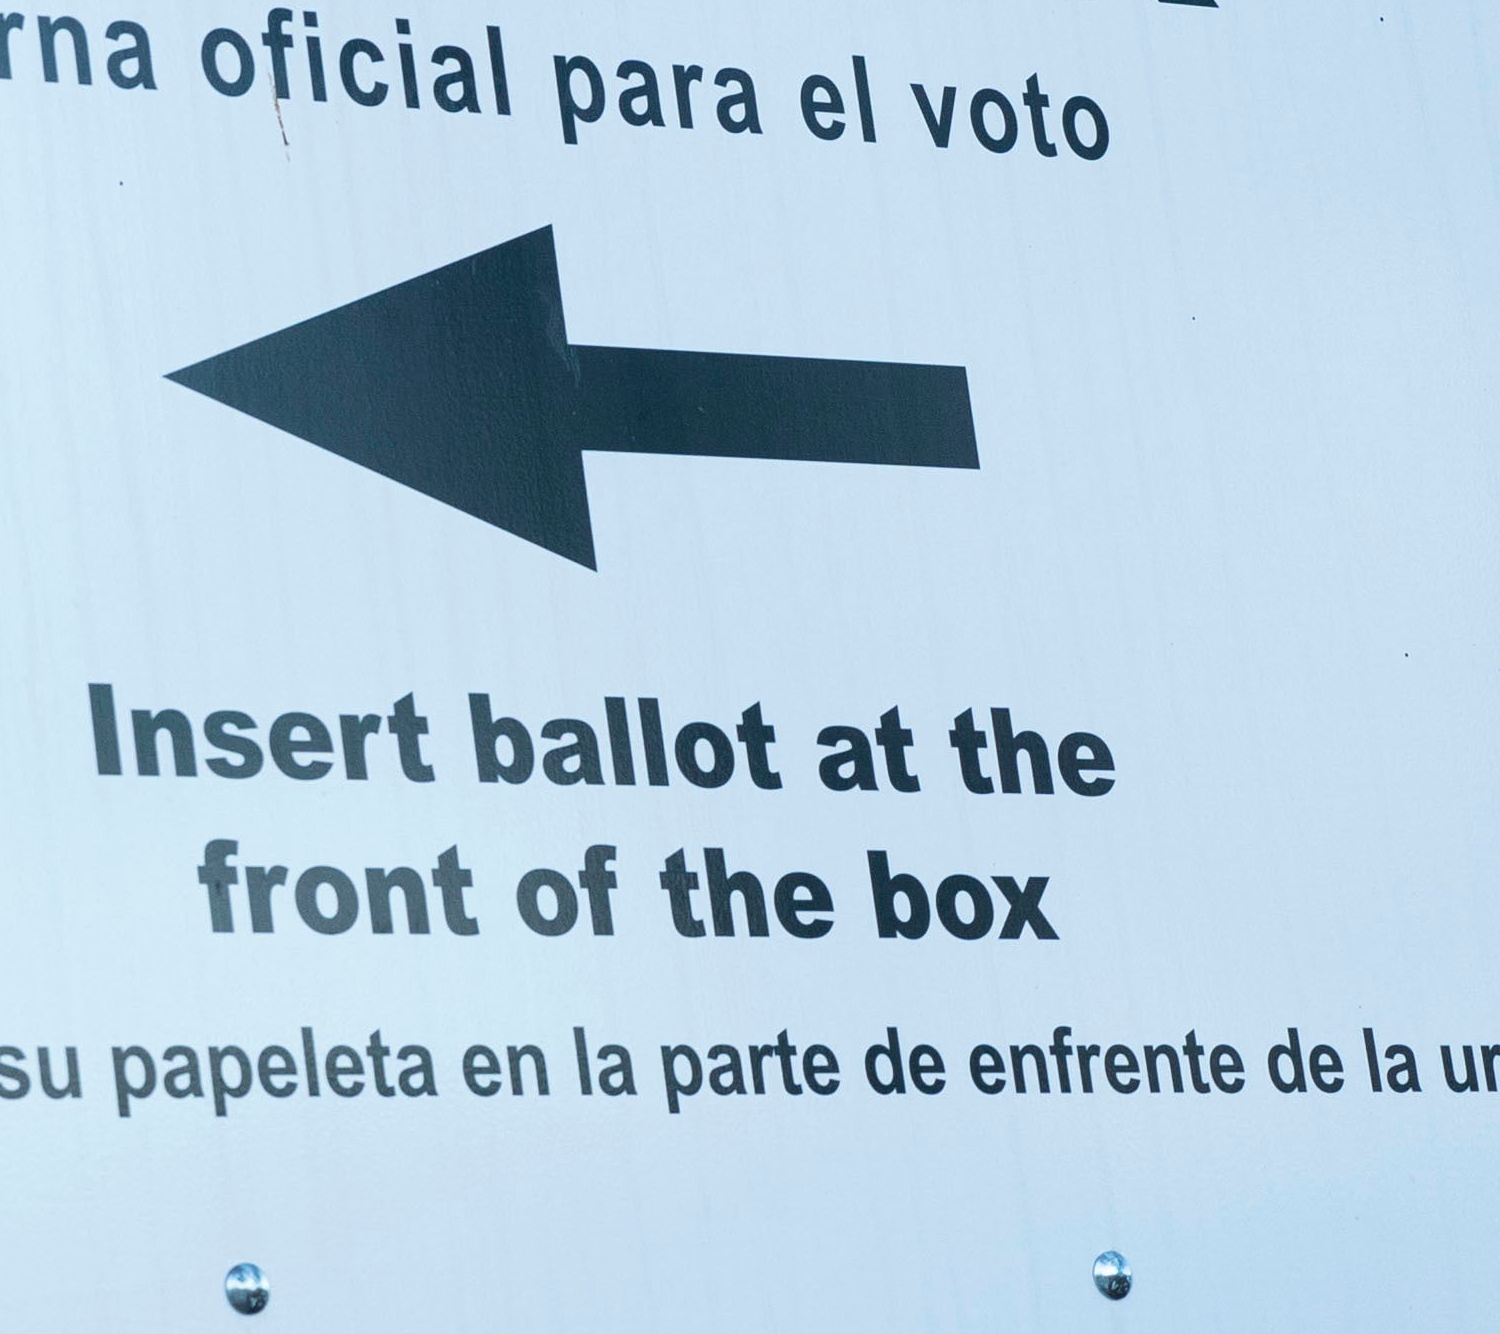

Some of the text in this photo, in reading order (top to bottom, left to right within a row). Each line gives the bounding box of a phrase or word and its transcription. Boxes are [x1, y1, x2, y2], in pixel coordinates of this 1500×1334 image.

[201, 8, 511, 115] oficial
[554, 55, 762, 144] para
[801, 55, 876, 143] el
[910, 73, 1109, 160] voto
[88, 683, 1115, 796] Insert ballot at the
[197, 839, 1059, 940] front of the box
[112, 1027, 438, 1117] papeleta
[463, 1045, 549, 1097] en
[573, 1027, 637, 1096] la
[661, 1029, 840, 1114] parte
[865, 1027, 945, 1095] de
[970, 1026, 1245, 1094] enfrente
[1268, 1028, 1344, 1093] de
[1363, 1028, 1422, 1093] la
